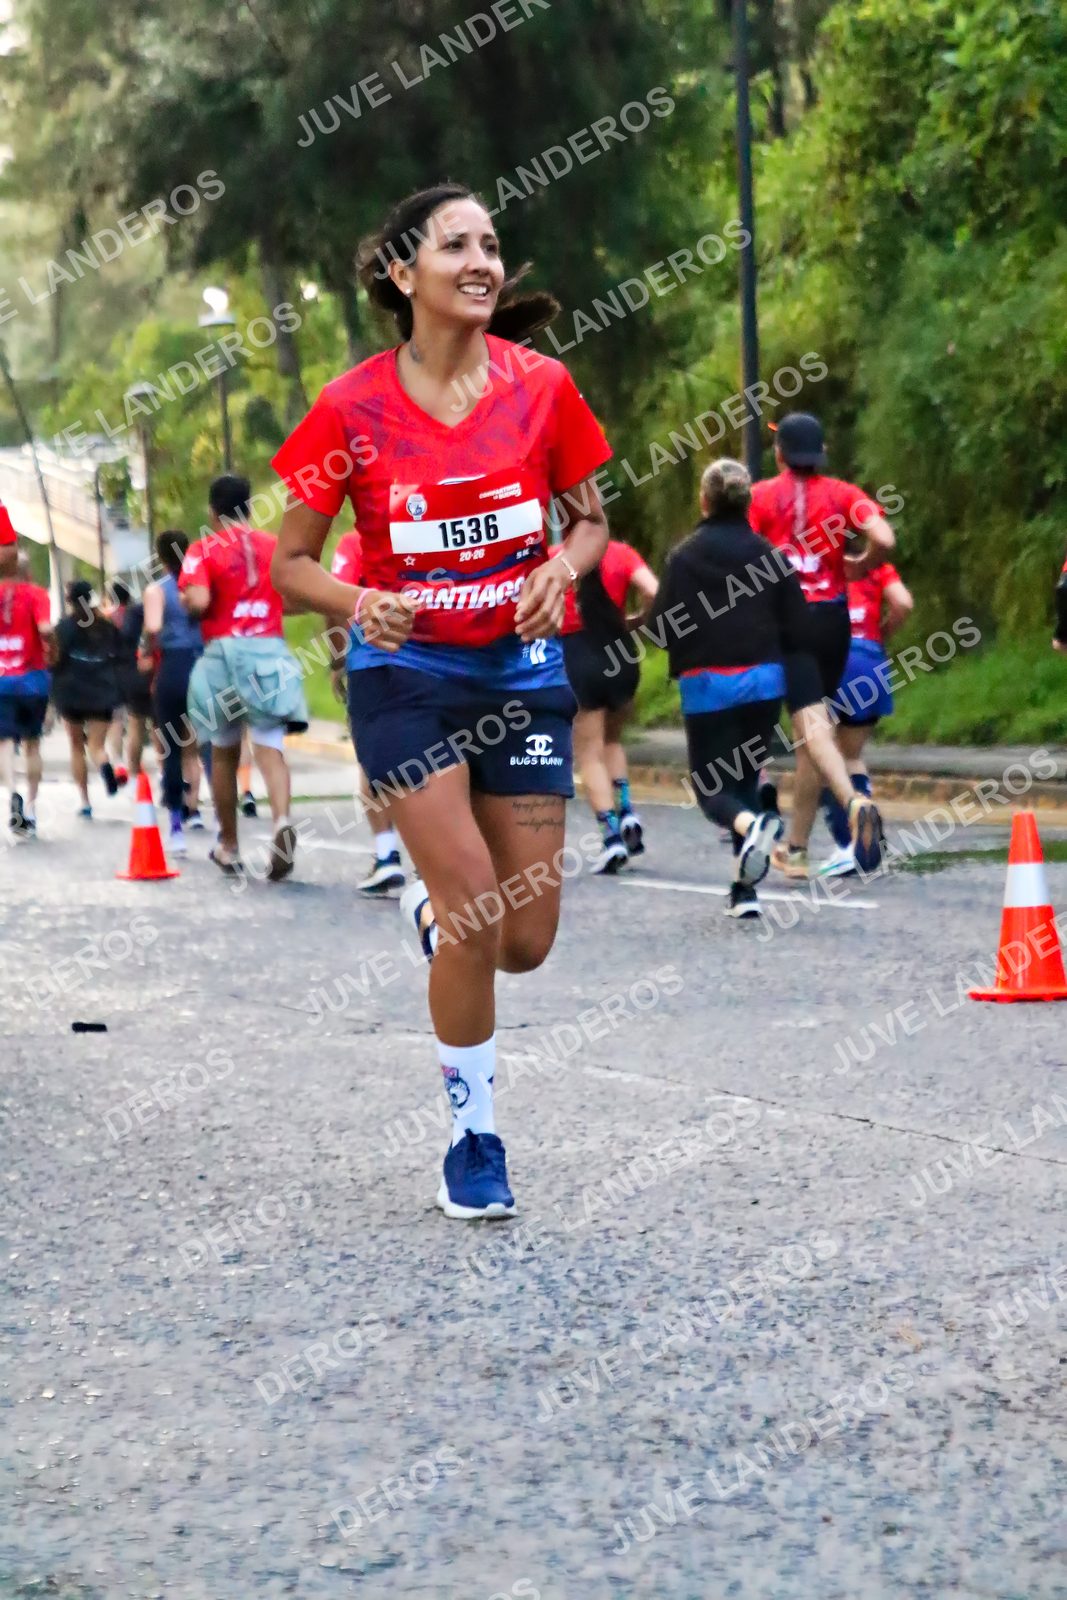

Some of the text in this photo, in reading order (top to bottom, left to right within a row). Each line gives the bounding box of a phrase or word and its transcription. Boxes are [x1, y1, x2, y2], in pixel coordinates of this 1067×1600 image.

[438, 514, 499, 548] 1536
[510, 756, 564, 766] BUGS BUNNY
